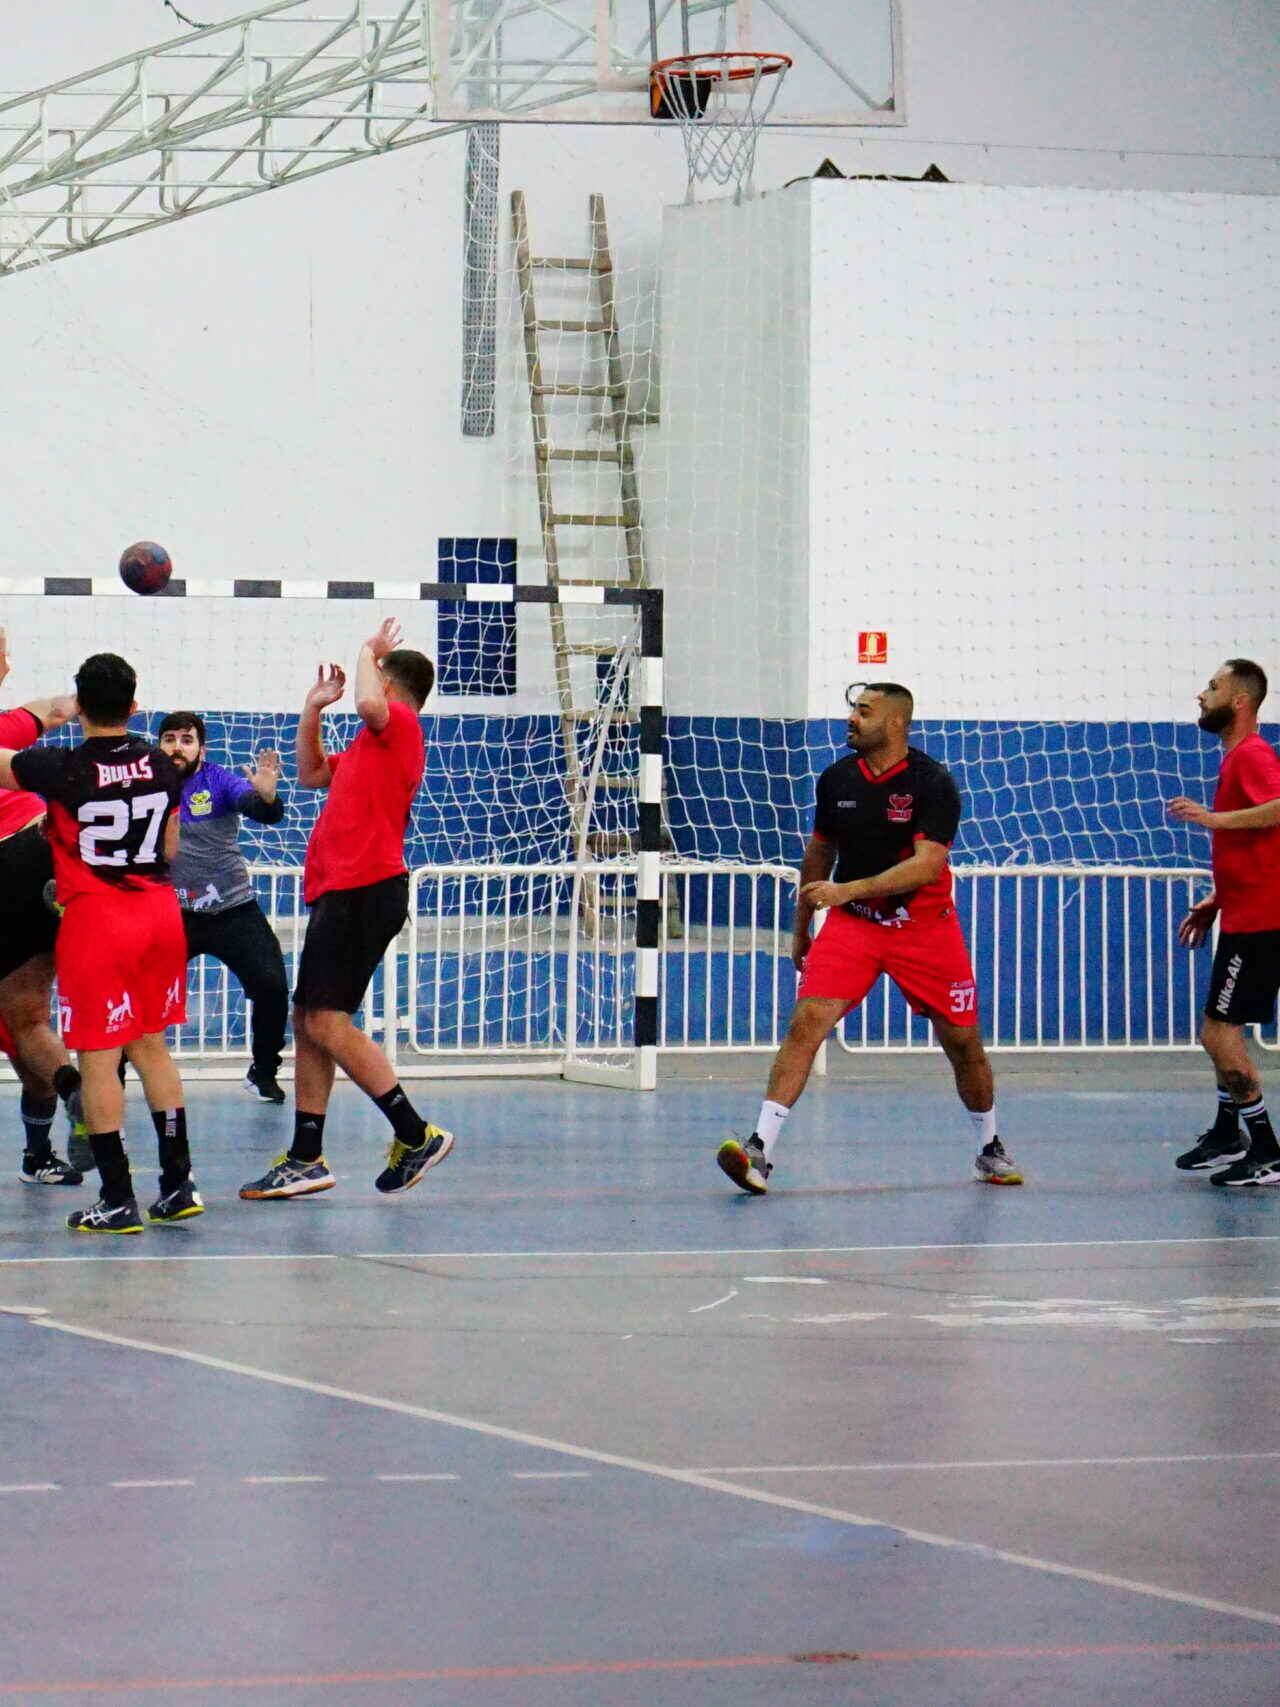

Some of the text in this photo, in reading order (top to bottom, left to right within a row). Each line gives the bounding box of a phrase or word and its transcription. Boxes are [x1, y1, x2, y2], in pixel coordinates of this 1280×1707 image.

[95, 754, 154, 788] BULLS
[77, 791, 169, 866] 27
[949, 986, 975, 1013] 37
[1216, 954, 1242, 1015] Nike Air
